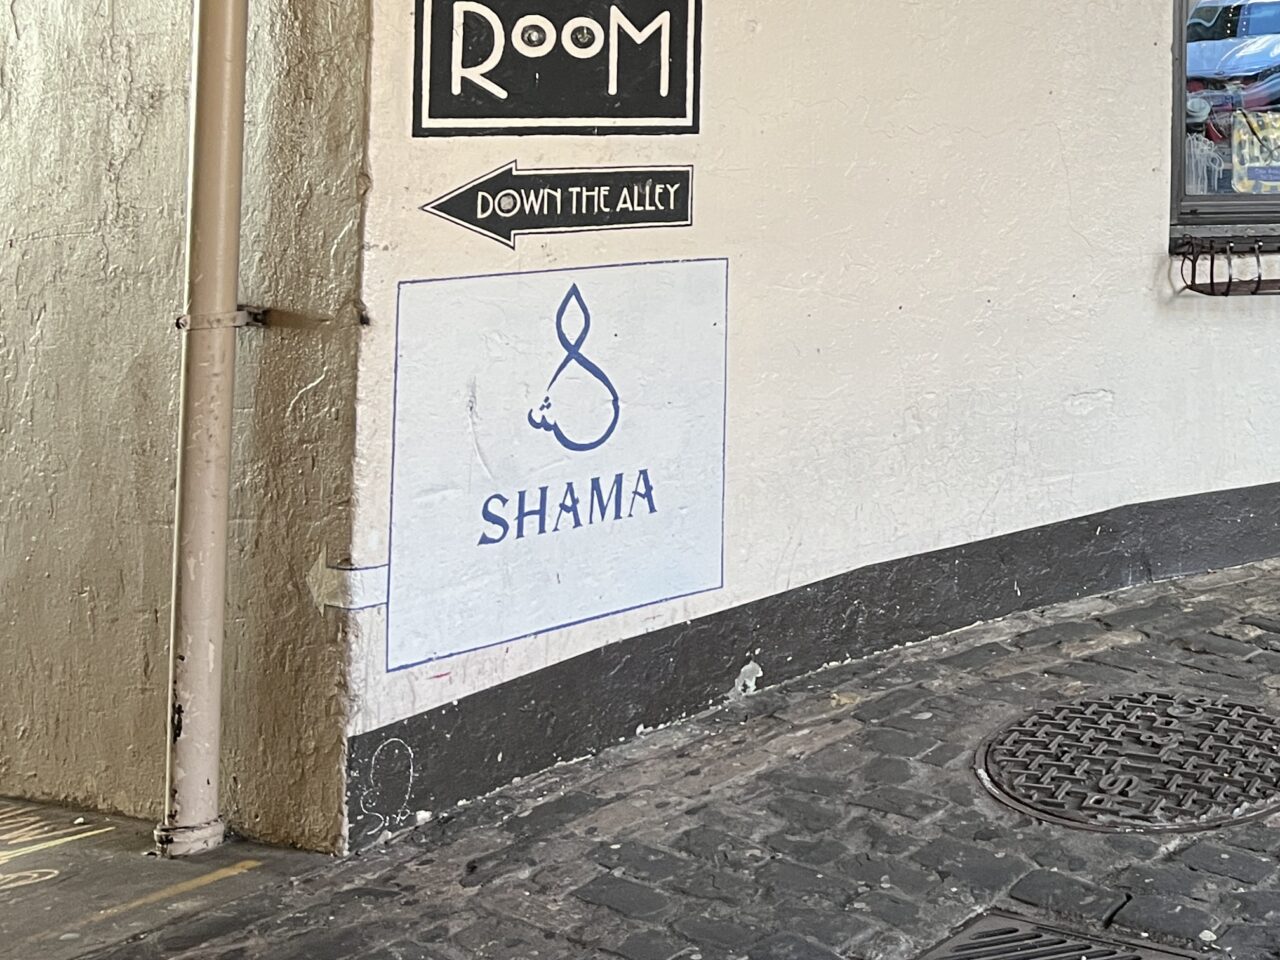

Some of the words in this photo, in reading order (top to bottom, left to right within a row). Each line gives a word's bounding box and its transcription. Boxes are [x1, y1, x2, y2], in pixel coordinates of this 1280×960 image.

[451, 0, 670, 99] ROOM
[477, 188, 561, 219] DOWN
[568, 186, 611, 215] THE
[616, 183, 680, 212] ALLEY
[477, 468, 657, 546] SHAMA
